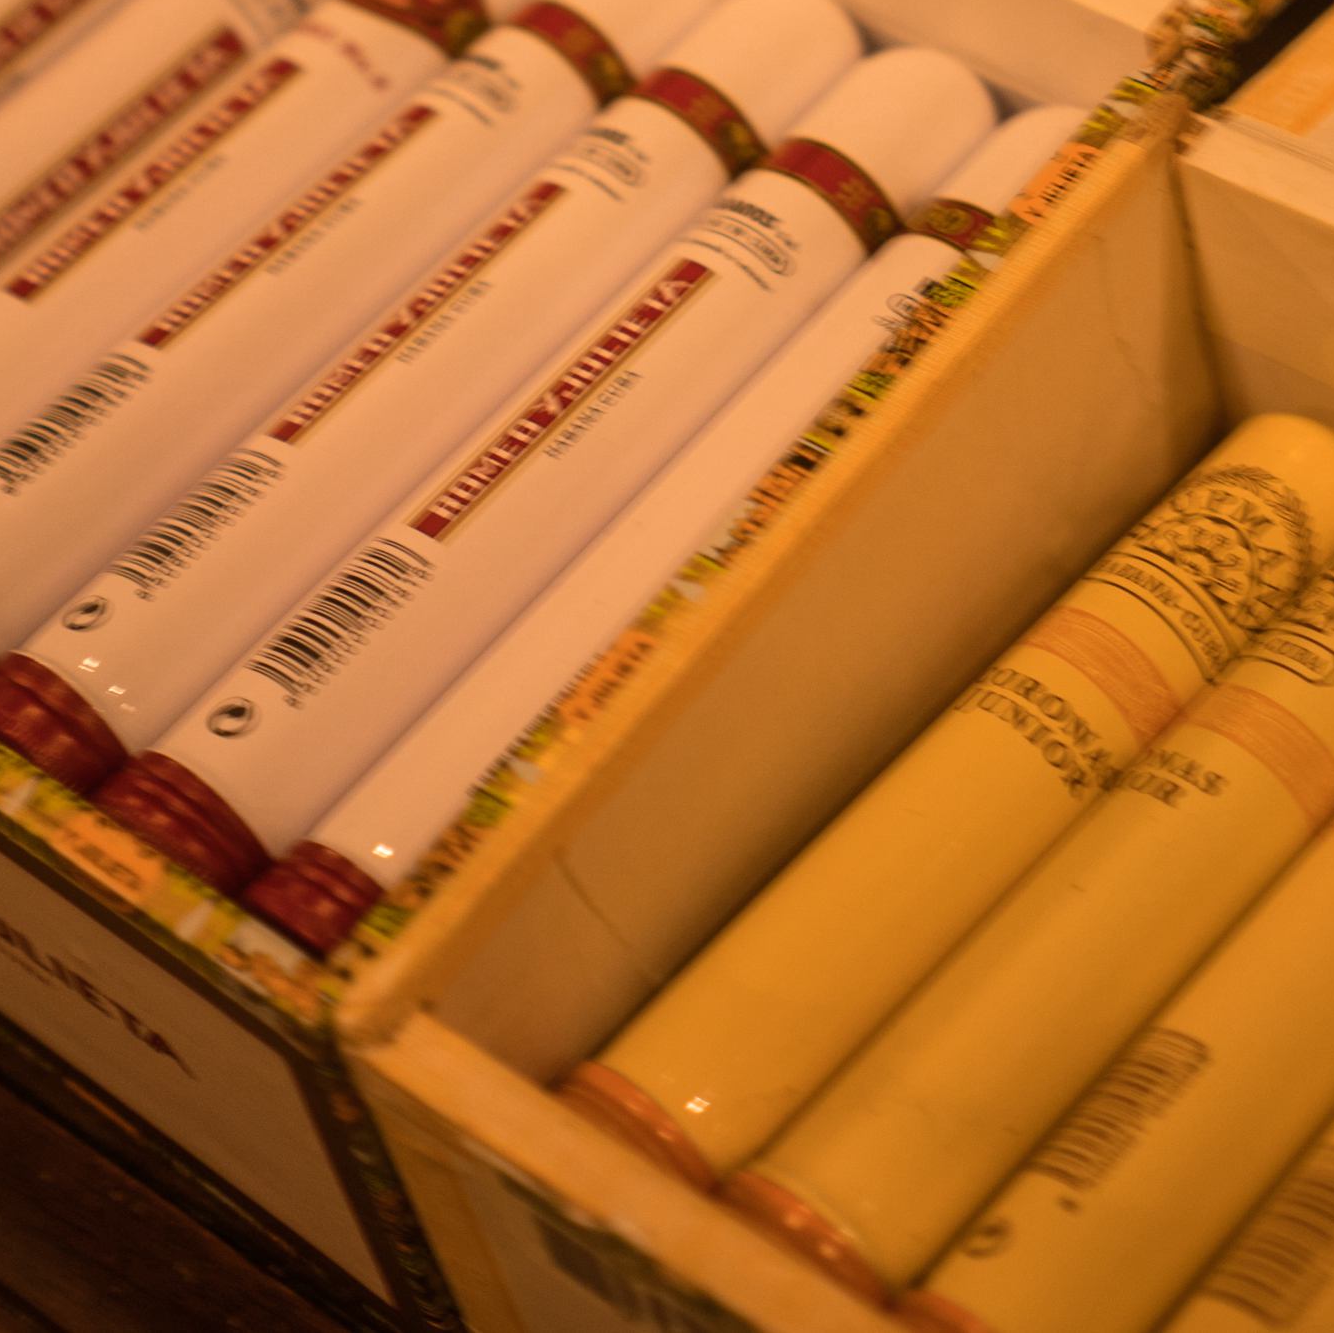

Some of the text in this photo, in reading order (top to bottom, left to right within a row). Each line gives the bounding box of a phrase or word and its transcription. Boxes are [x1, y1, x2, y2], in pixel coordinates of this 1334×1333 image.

[427, 417, 546, 520] ROMEO
[554, 276, 693, 398] JULIETA
[540, 404, 606, 459] HABANA
